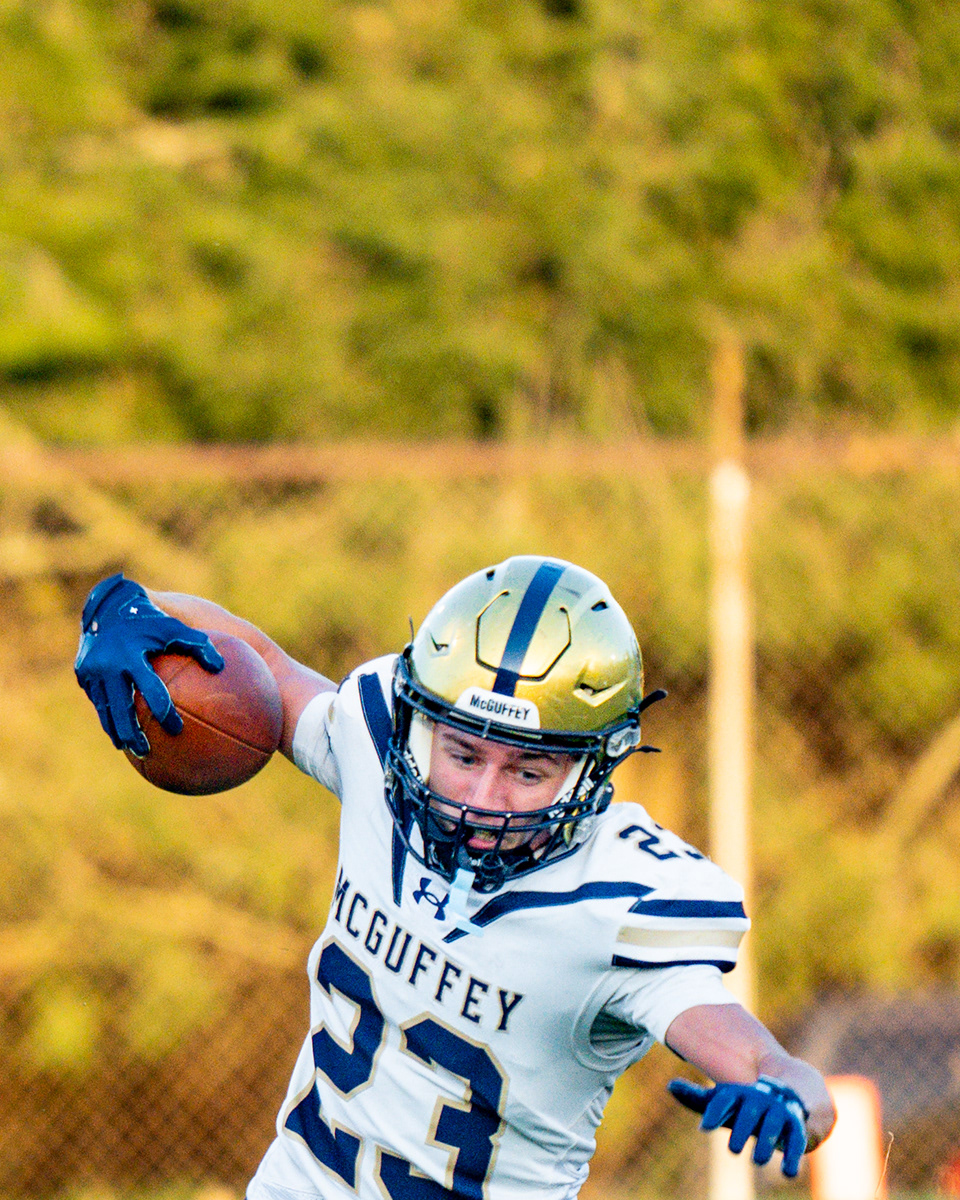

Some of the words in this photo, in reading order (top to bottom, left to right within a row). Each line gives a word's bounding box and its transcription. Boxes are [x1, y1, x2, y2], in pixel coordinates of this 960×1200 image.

[470, 694, 530, 720] McGUFFEY
[617, 823, 704, 861] 2
[333, 865, 525, 1033] MCGUFFEY
